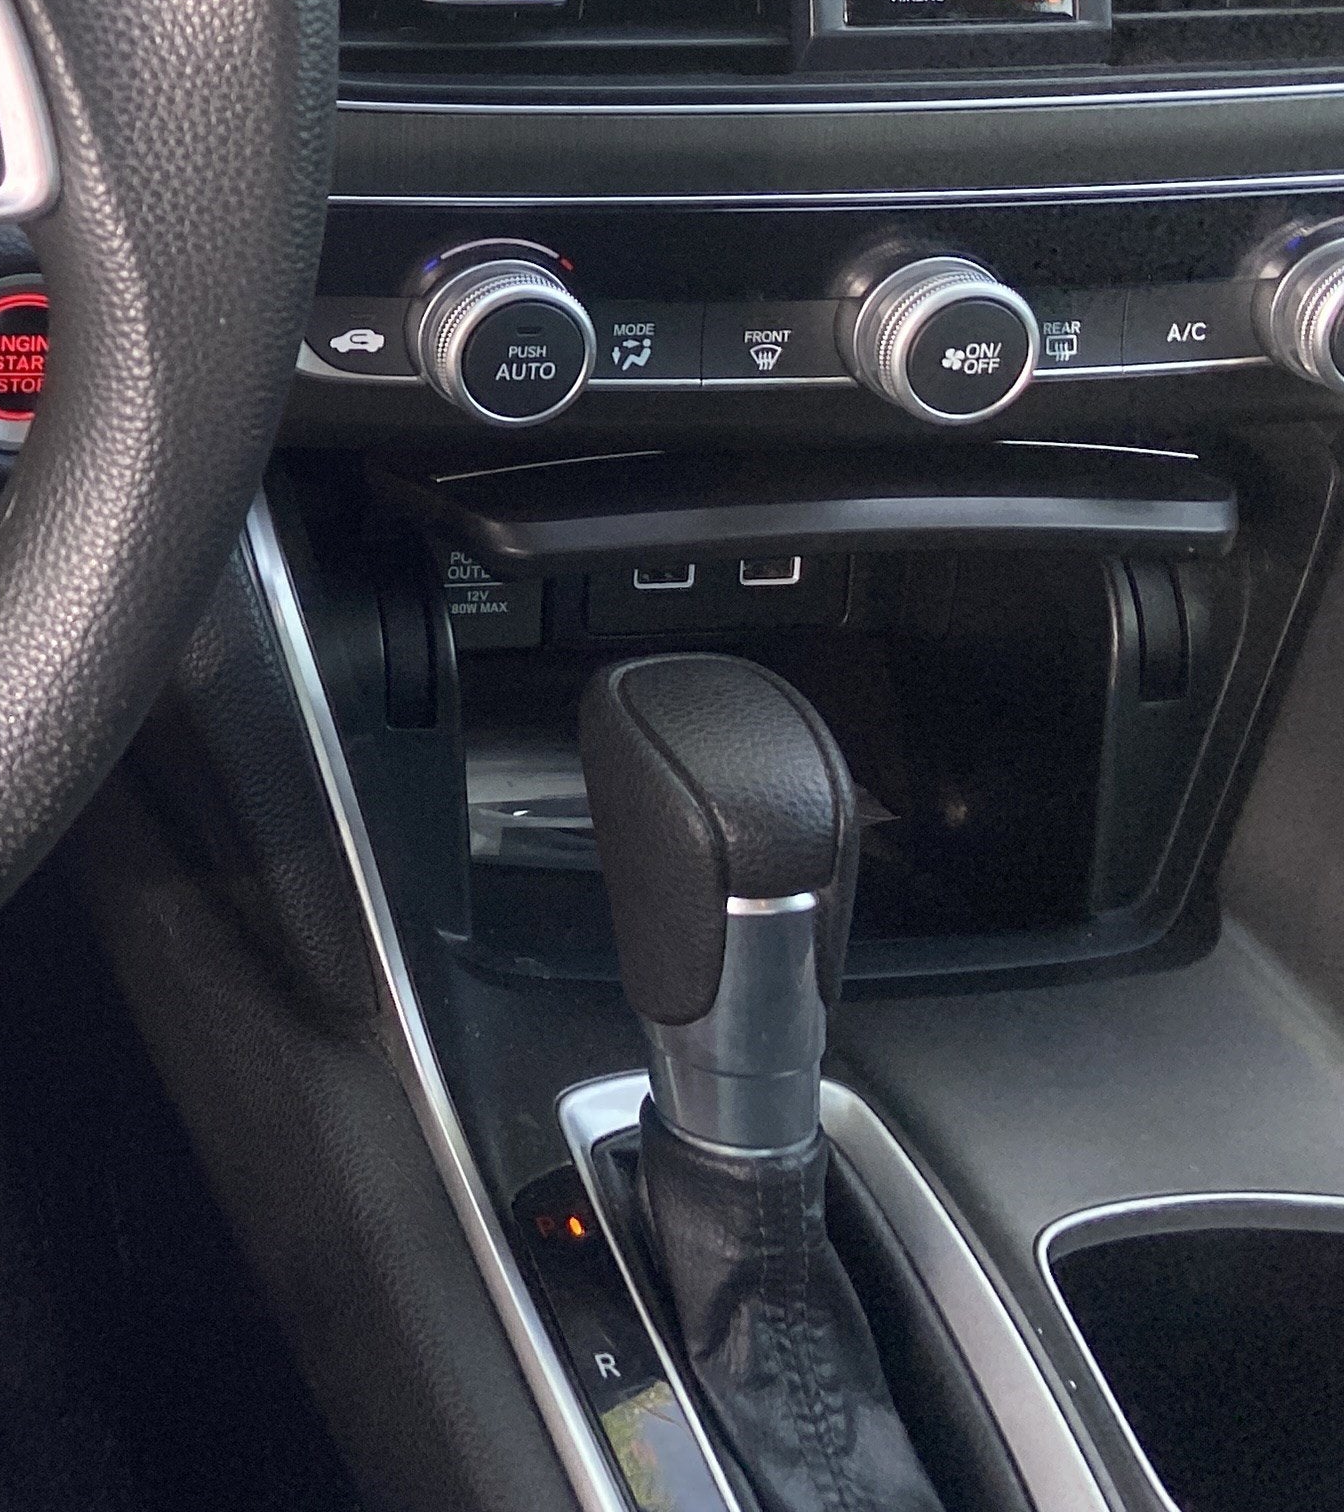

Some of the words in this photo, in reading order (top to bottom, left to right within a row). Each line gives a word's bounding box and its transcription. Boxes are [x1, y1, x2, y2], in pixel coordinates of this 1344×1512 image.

[613, 324, 654, 336] MODE
[1043, 322, 1081, 335] REAR
[1167, 322, 1206, 343] A/C
[744, 330, 791, 343] FRONT
[508, 345, 547, 359] PUSH
[965, 342, 1002, 360] ON/
[495, 362, 556, 381] AUTO
[964, 357, 1001, 375] OFF
[448, 565, 491, 579] OUTL
[467, 590, 489, 601] 12V
[480, 602, 508, 613] MAX
[594, 1352, 621, 1378] R
